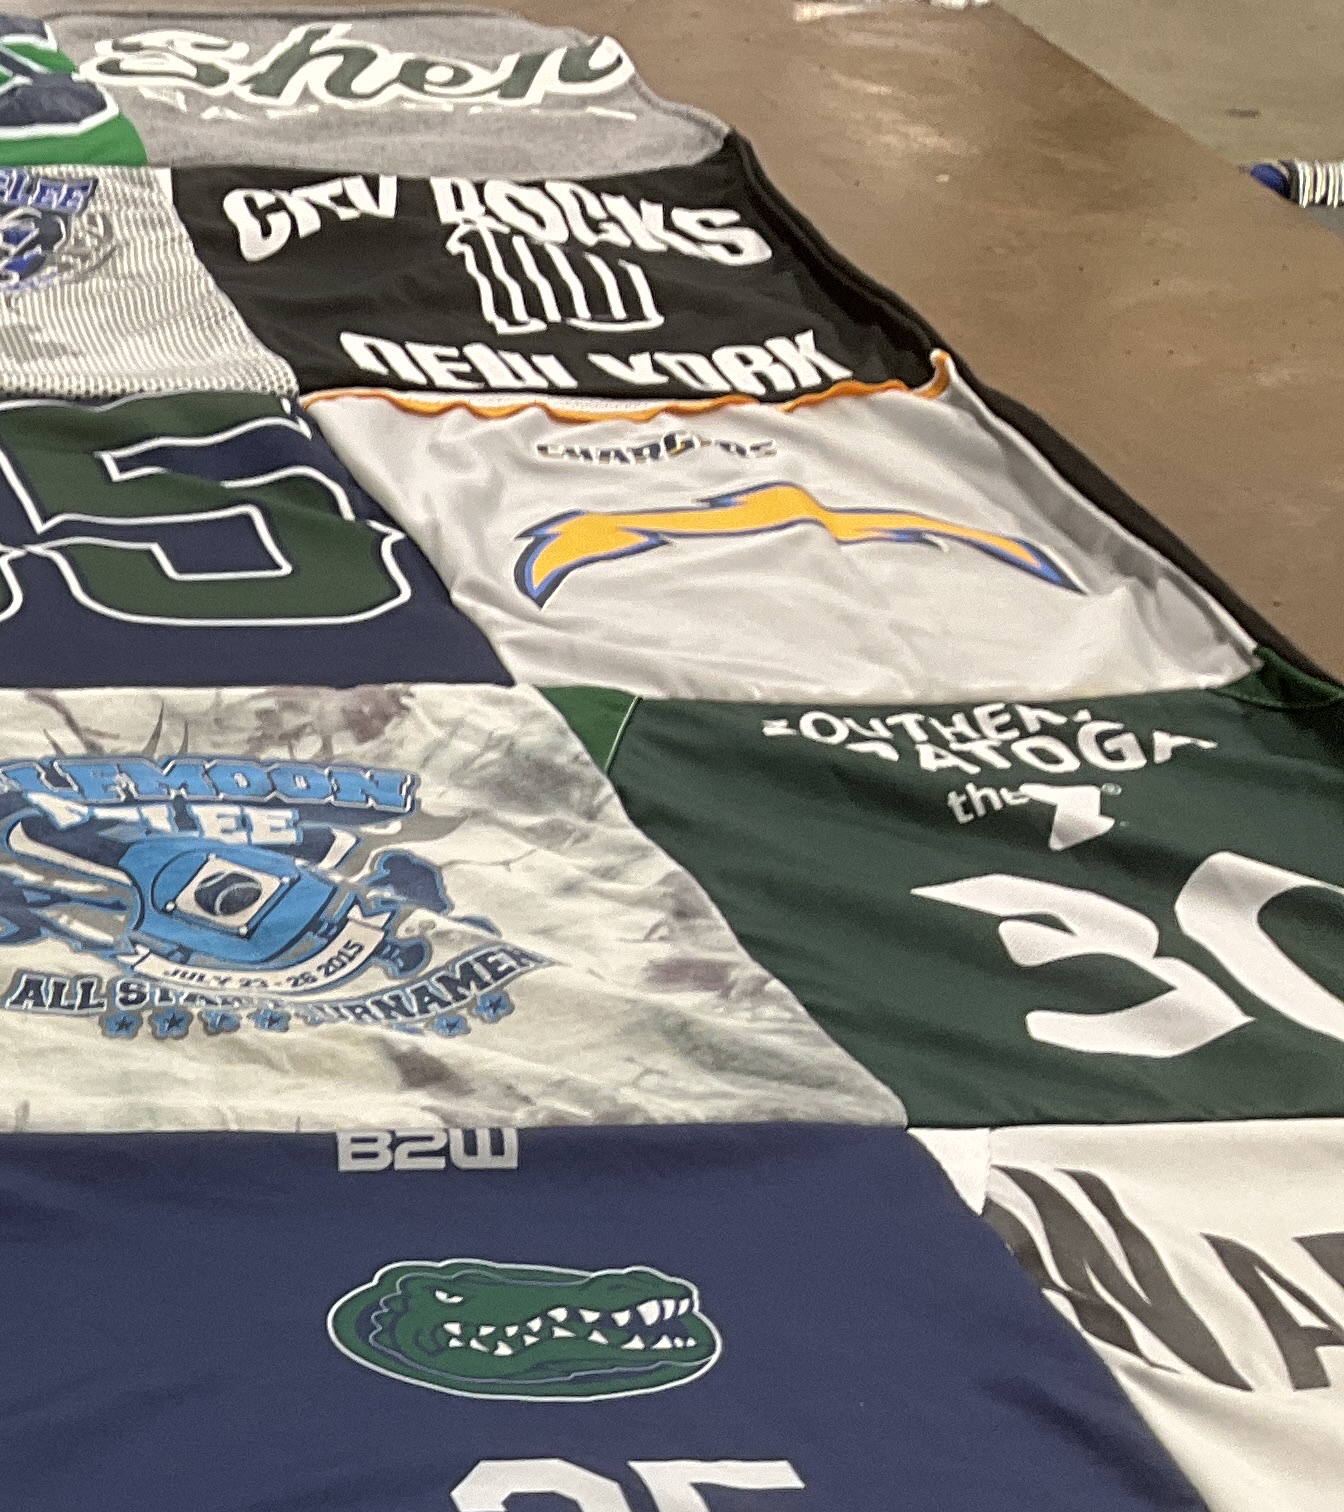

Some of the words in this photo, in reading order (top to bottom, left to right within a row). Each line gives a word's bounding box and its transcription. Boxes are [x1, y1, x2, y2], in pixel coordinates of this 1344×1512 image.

[429, 175, 774, 267] ROCKS
[338, 331, 578, 390] NEW
[588, 329, 855, 395] YORK
[315, 938, 366, 978] 2015
[2, 971, 109, 1013] ALL
[334, 1127, 519, 1172] B2W
